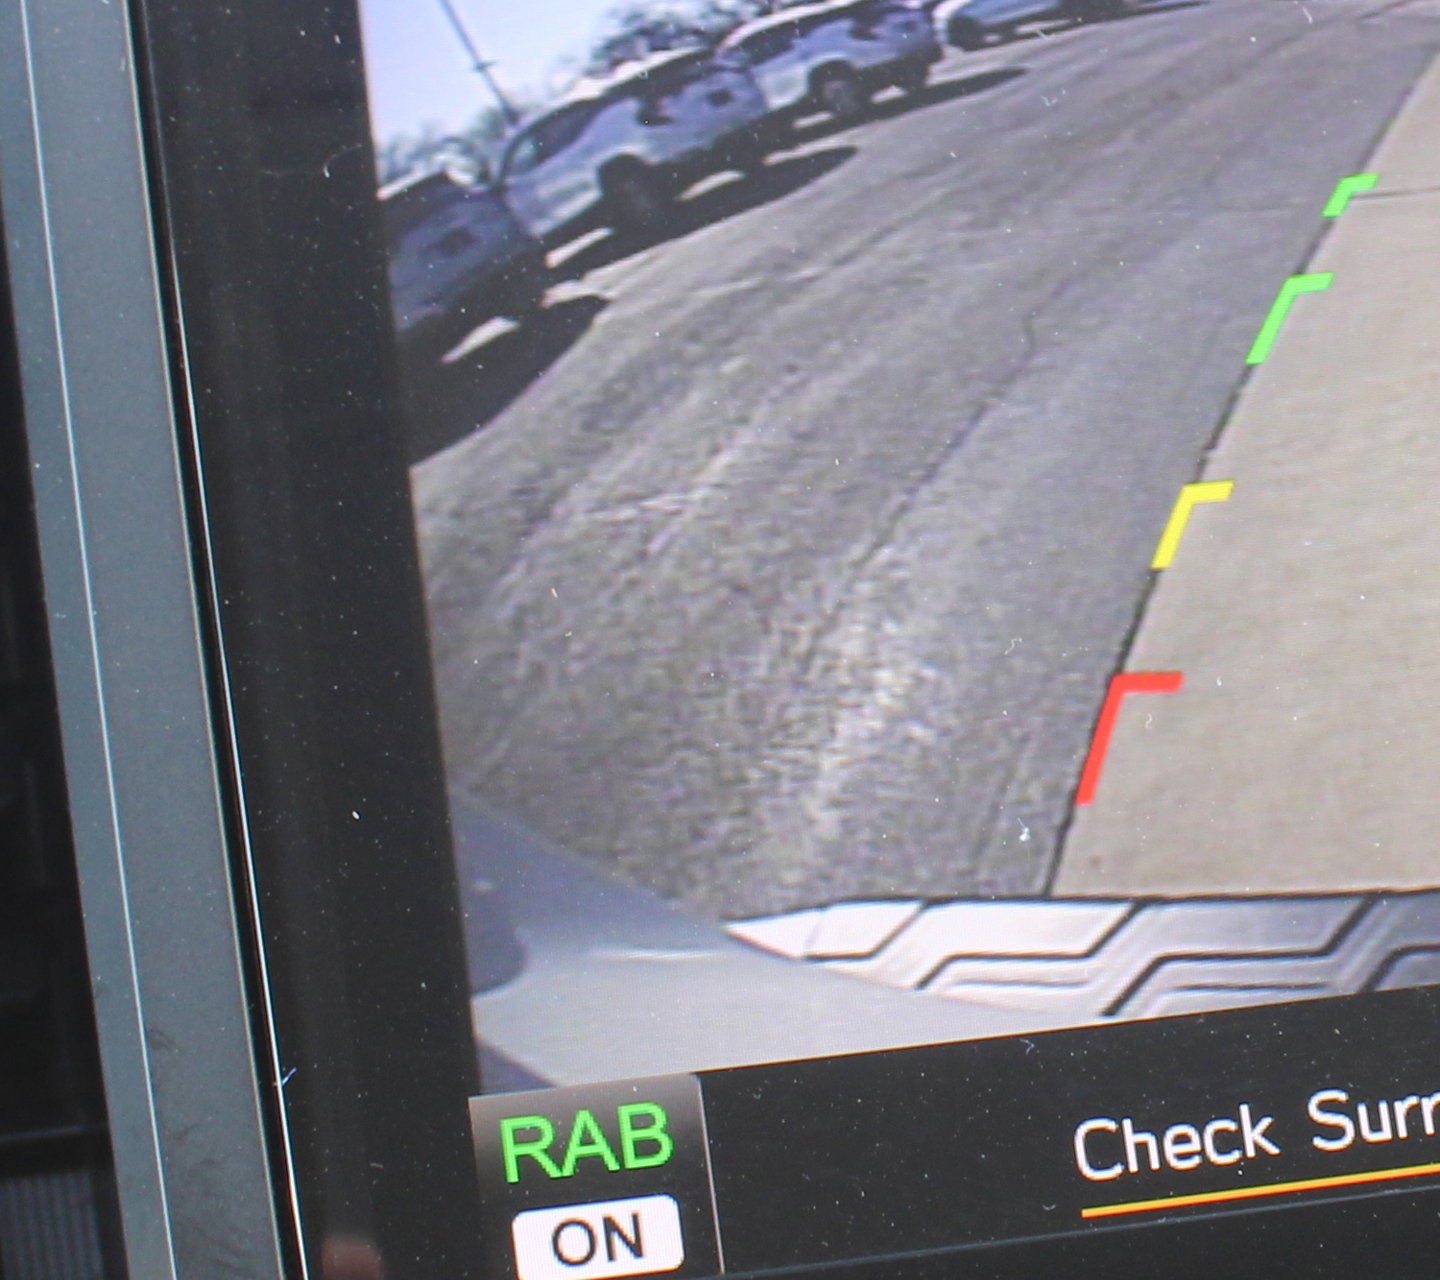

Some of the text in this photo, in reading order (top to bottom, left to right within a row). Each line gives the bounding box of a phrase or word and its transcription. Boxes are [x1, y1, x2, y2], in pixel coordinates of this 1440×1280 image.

[499, 1101, 676, 1184] RAB
[1073, 1103, 1282, 1182] Check
[550, 1211, 646, 1268] ON
